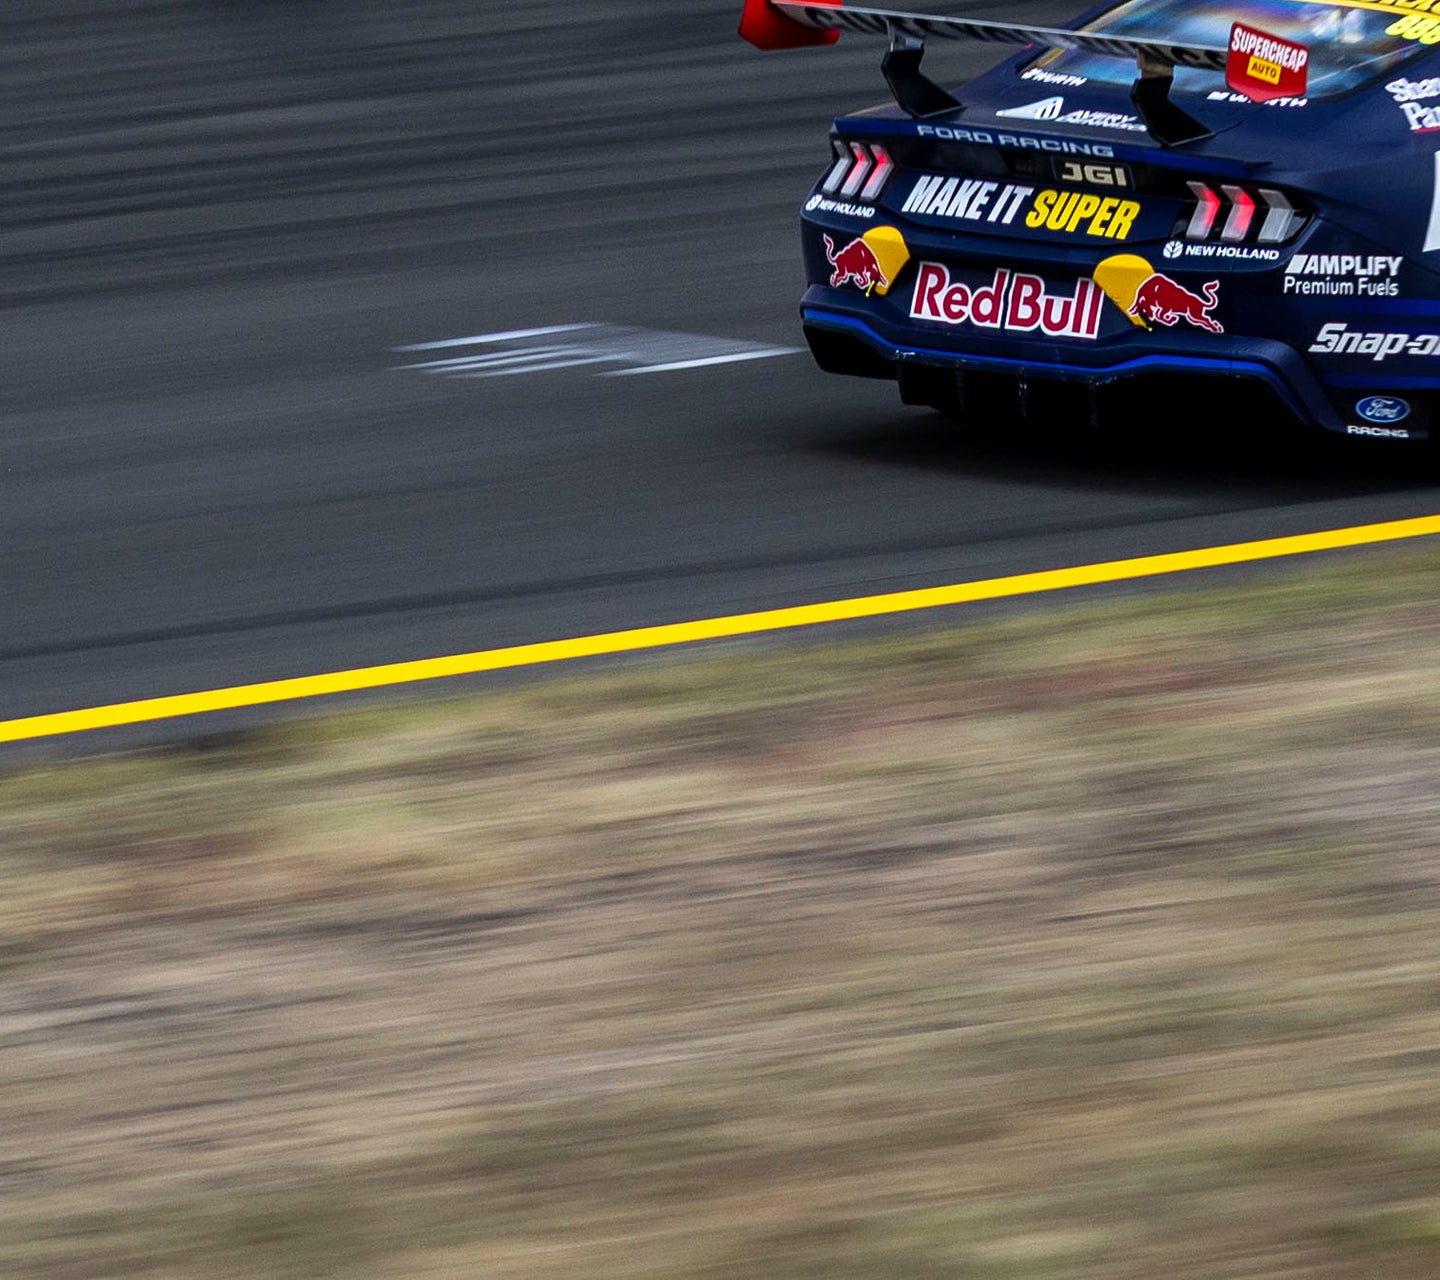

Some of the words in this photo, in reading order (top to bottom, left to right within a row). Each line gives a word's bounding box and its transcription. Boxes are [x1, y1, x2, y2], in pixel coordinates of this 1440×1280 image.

[1232, 26, 1308, 73] SUPERCHEAP
[1250, 60, 1279, 79] AUTO
[916, 124, 992, 144] FORD
[997, 133, 1115, 158] RACING
[1061, 162, 1128, 187] JGI
[818, 199, 837, 211] NEW
[834, 202, 876, 218] HOLLAND
[901, 175, 996, 221] MAKE
[987, 183, 1035, 225] IT
[1025, 189, 1141, 240] SUPER
[1185, 245, 1216, 258] NEW
[1215, 246, 1280, 261] HOLLAND
[1303, 254, 1403, 277] AMPLIFY
[1283, 275, 1354, 296] Premium
[1357, 277, 1400, 296] Fuels
[910, 260, 1011, 325] Red
[1004, 272, 1105, 340] Bull
[1364, 398, 1399, 420] Ford
[1346, 425, 1410, 439] RACING
